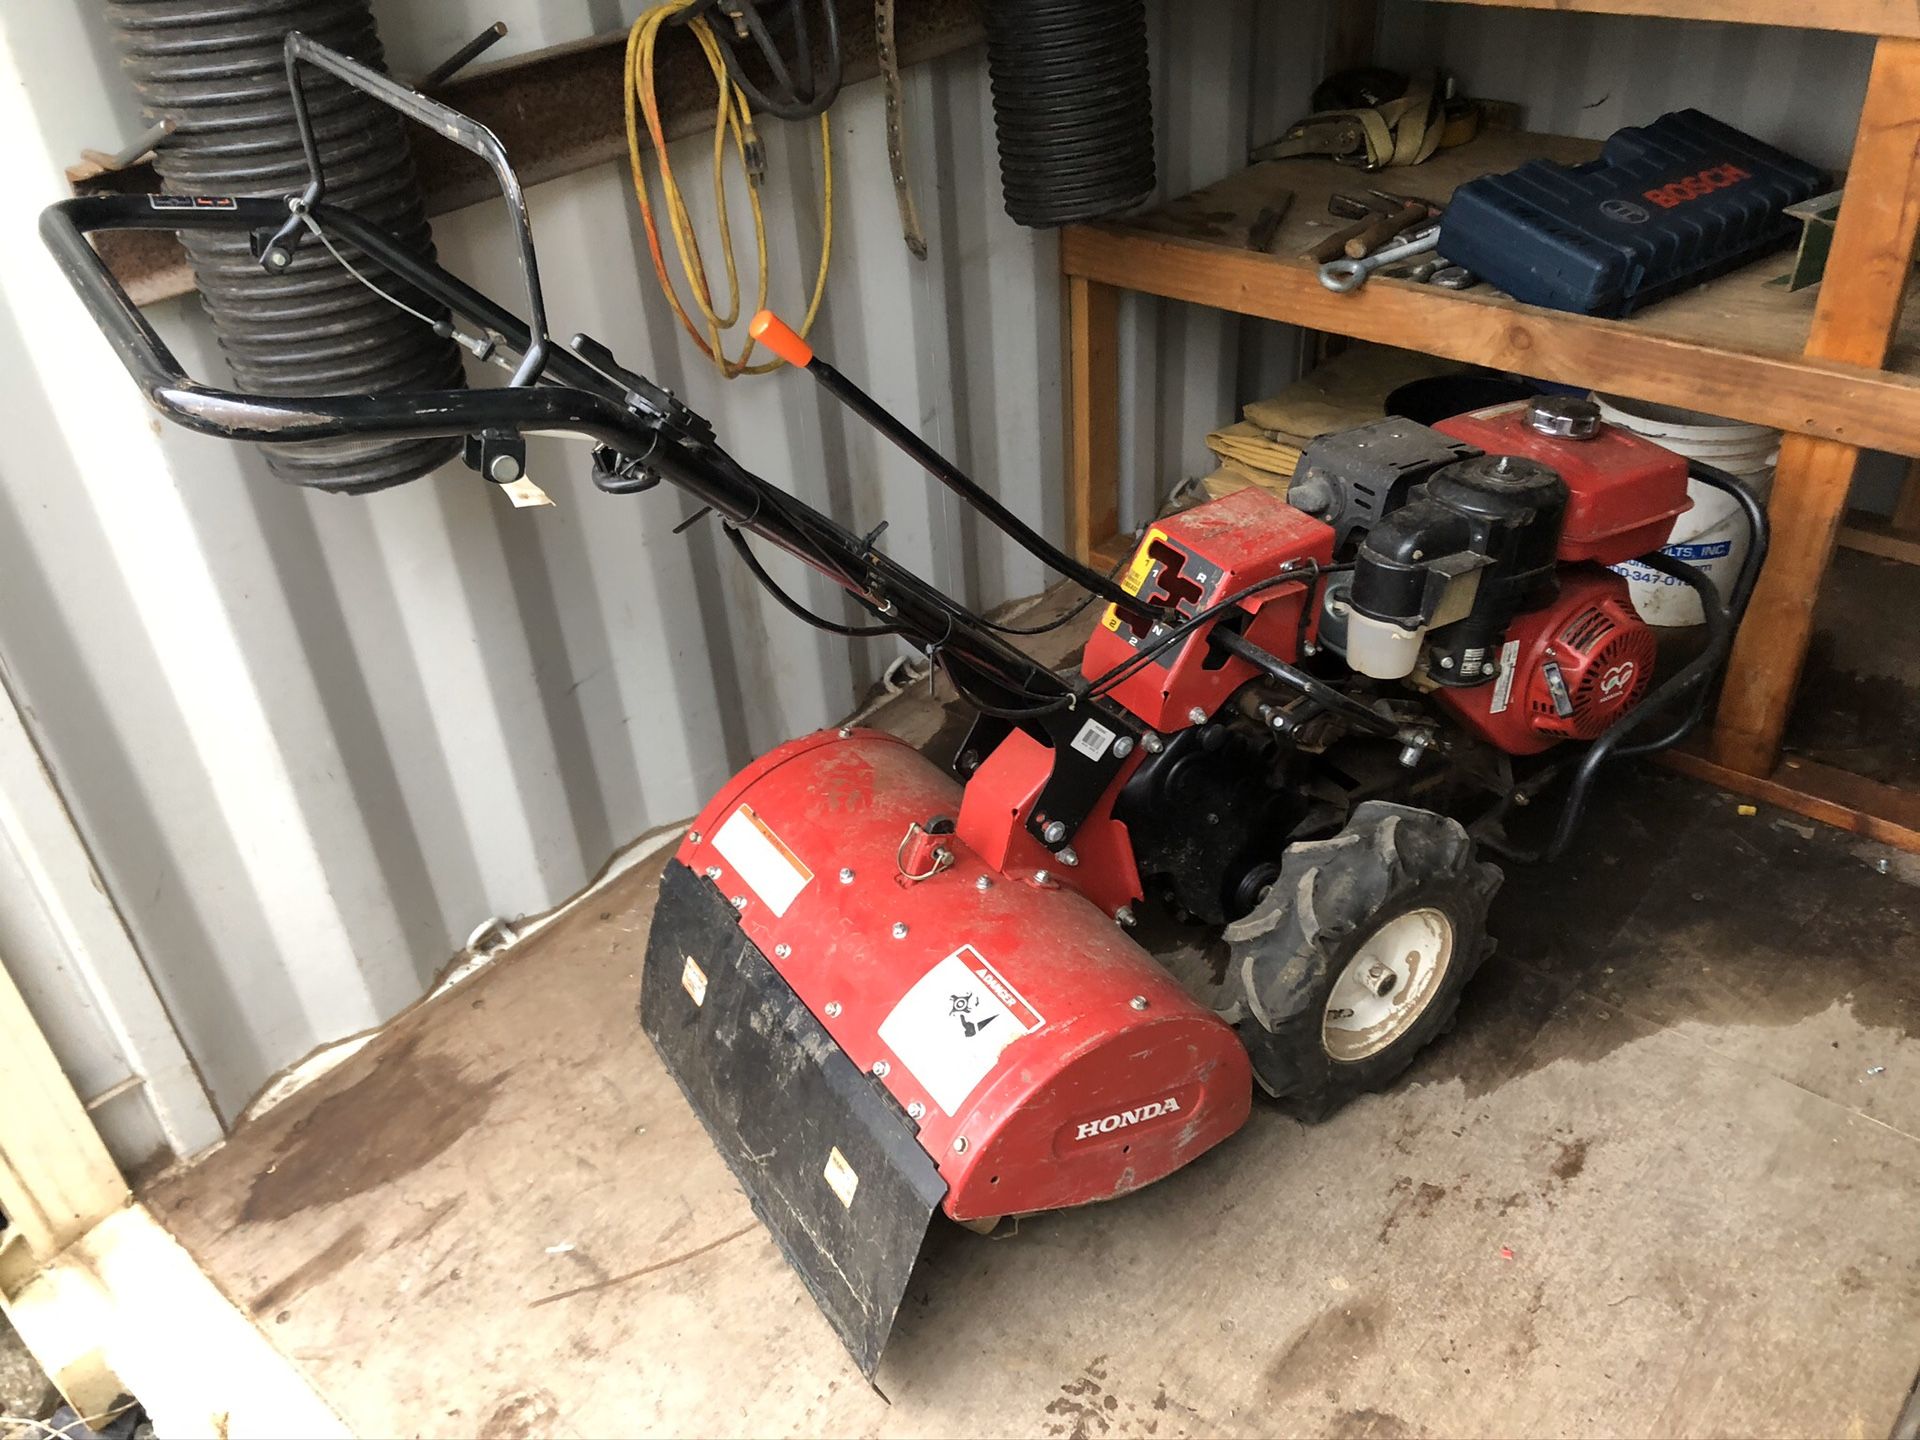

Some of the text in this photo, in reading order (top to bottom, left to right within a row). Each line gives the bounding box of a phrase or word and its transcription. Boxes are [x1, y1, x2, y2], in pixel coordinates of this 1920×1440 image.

[1642, 164, 1752, 208] BOSCH
[1152, 569, 1158, 577] 1
[1196, 572, 1207, 583] R
[1109, 619, 1117, 628] 2
[1152, 625, 1163, 636] N
[1128, 637, 1138, 647] 2
[984, 974, 1017, 1007] DANGER
[1075, 1097, 1180, 1141] HONDA
